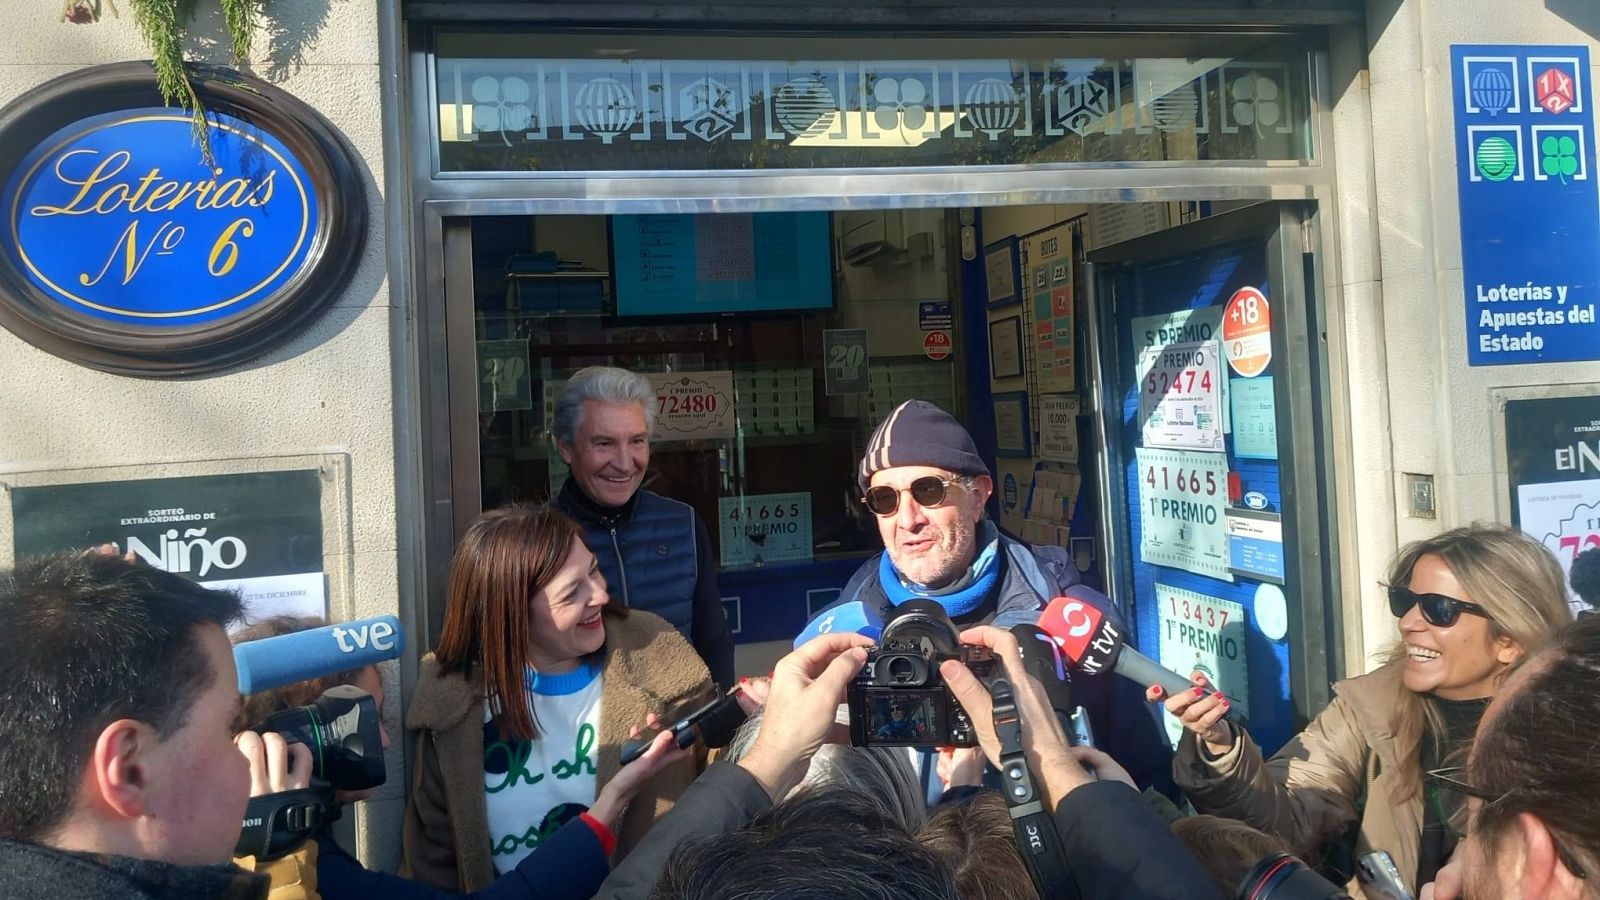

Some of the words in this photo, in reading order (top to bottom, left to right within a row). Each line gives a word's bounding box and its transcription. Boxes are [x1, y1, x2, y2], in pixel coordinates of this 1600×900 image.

[207, 218, 255, 278] 6
[1477, 281, 1552, 302] Loterías
[1556, 286, 1567, 304] y
[1231, 296, 1259, 325] +18
[1480, 308, 1564, 331] Apuestas
[1568, 304, 1595, 324] del
[1158, 323, 1212, 345] PREMIO
[1480, 332, 1544, 352] Estado
[1164, 352, 1204, 368] PREMIO
[1149, 370, 1212, 394] 52474
[657, 393, 717, 415] 72480
[1147, 466, 1216, 496] 41665
[121, 514, 201, 525] EXTRAORDINARIO
[203, 512, 216, 520] DE
[148, 508, 185, 517] SORTEO
[730, 504, 799, 521] 41665
[1162, 499, 1217, 525] PREMIO
[1170, 597, 1229, 631] 13437
[332, 622, 395, 653] tve
[1091, 620, 1119, 655] tvr
[1180, 623, 1237, 661] PREMIO
